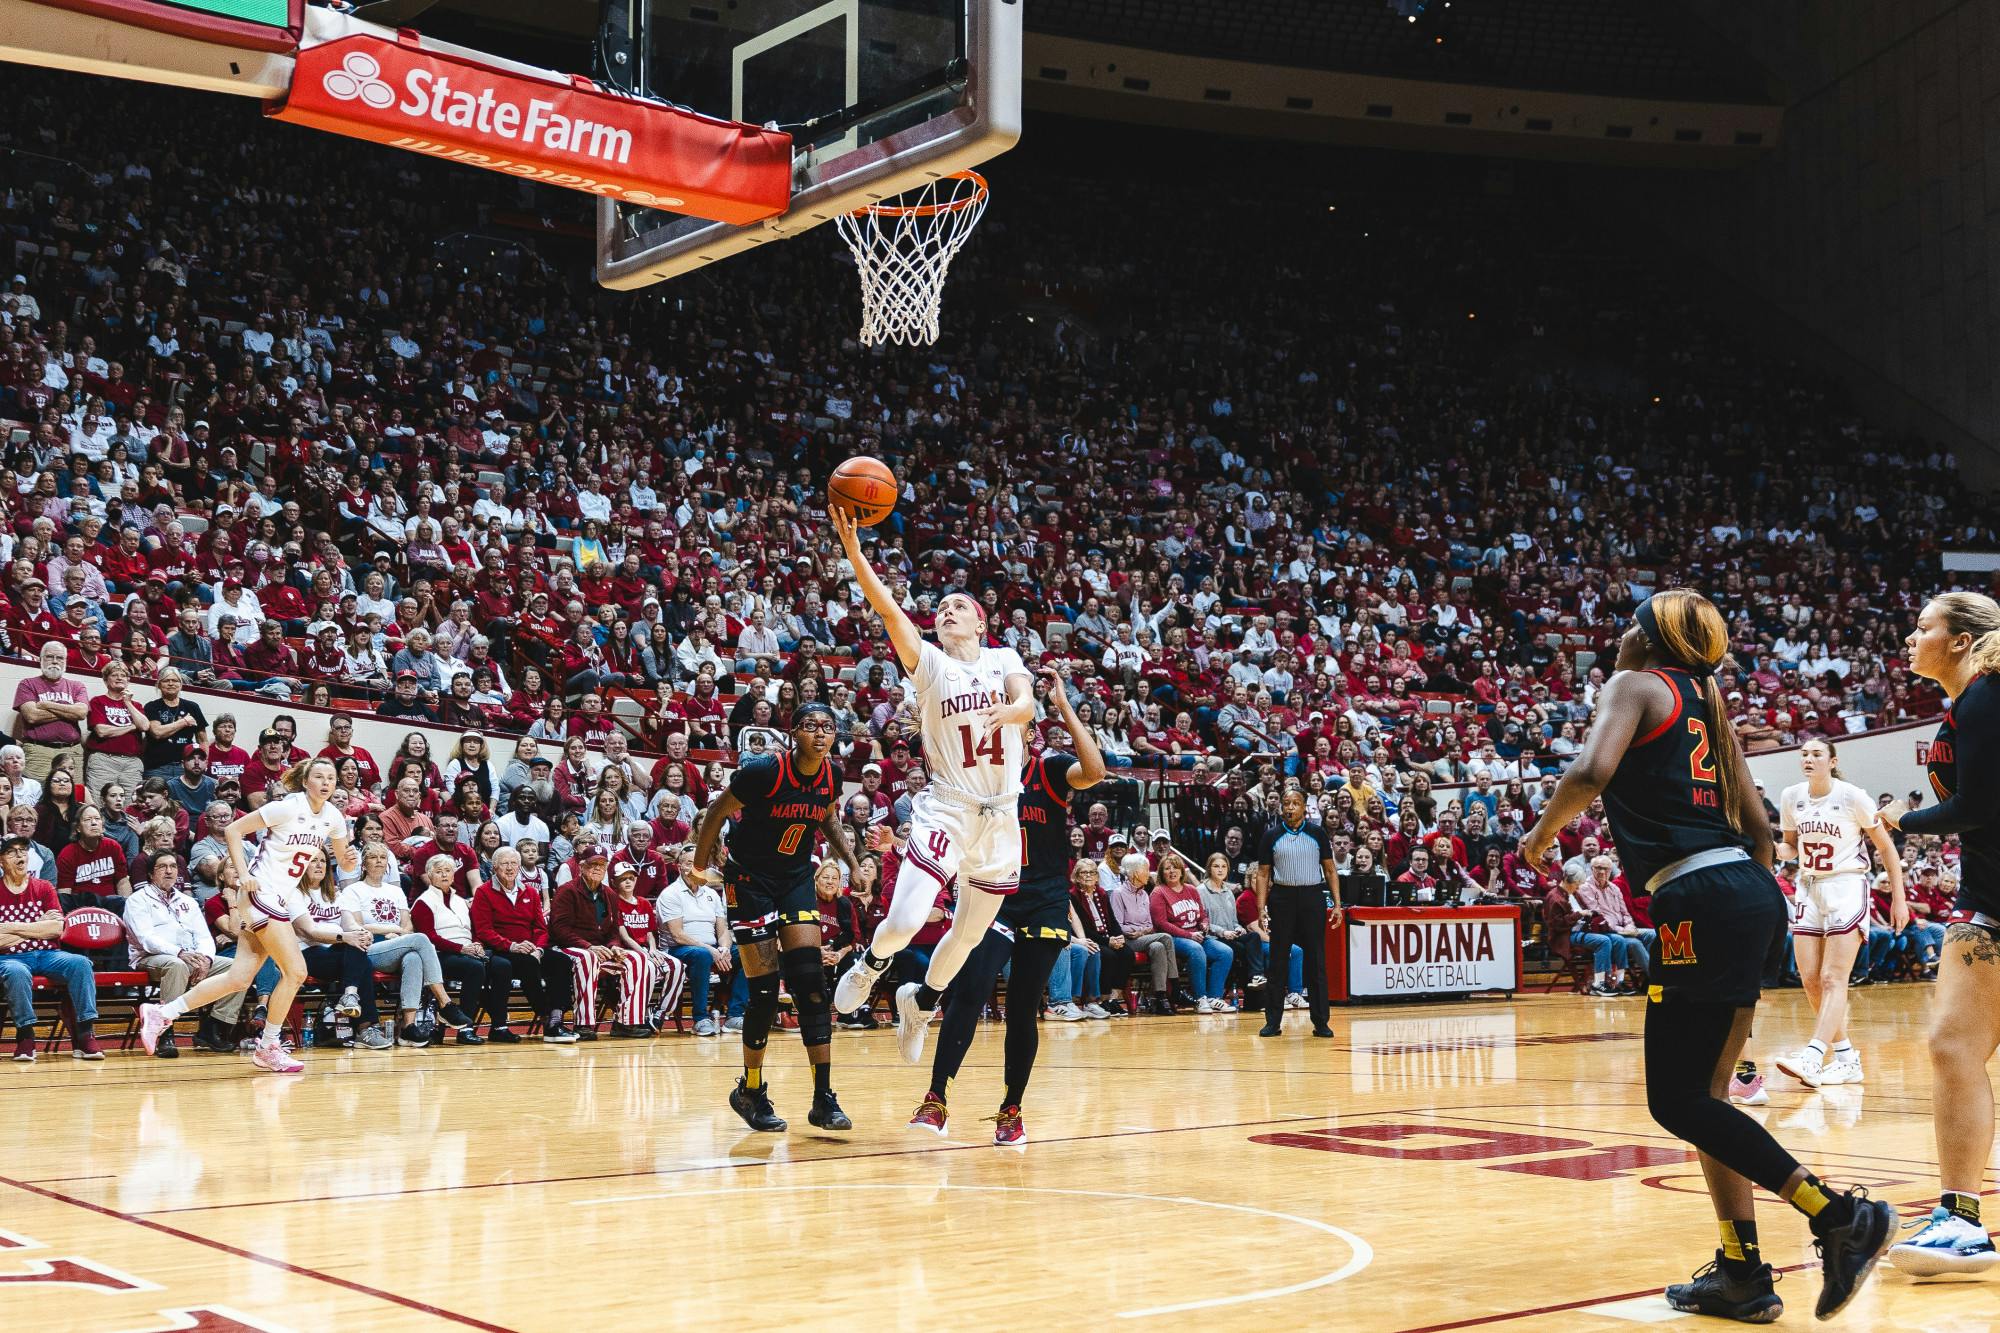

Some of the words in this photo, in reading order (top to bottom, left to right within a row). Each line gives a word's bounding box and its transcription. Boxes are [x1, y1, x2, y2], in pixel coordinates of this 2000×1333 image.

[958, 724, 1004, 769] 14
[1687, 717, 1717, 783] 2
[1926, 741, 1954, 765] AND
[892, 781, 907, 797] INDI
[1692, 787, 1718, 808] McD
[1019, 805, 1047, 824] AND
[286, 833, 324, 848] INDIAN
[778, 824, 806, 855] 0
[76, 856, 115, 879] INDIANA
[1802, 842, 1834, 871] 52
[67, 913, 119, 928] INDIANA
[1370, 922, 1495, 965] INDIANA
[1660, 920, 1697, 960] M
[1385, 964, 1482, 989] BASKETBALL
